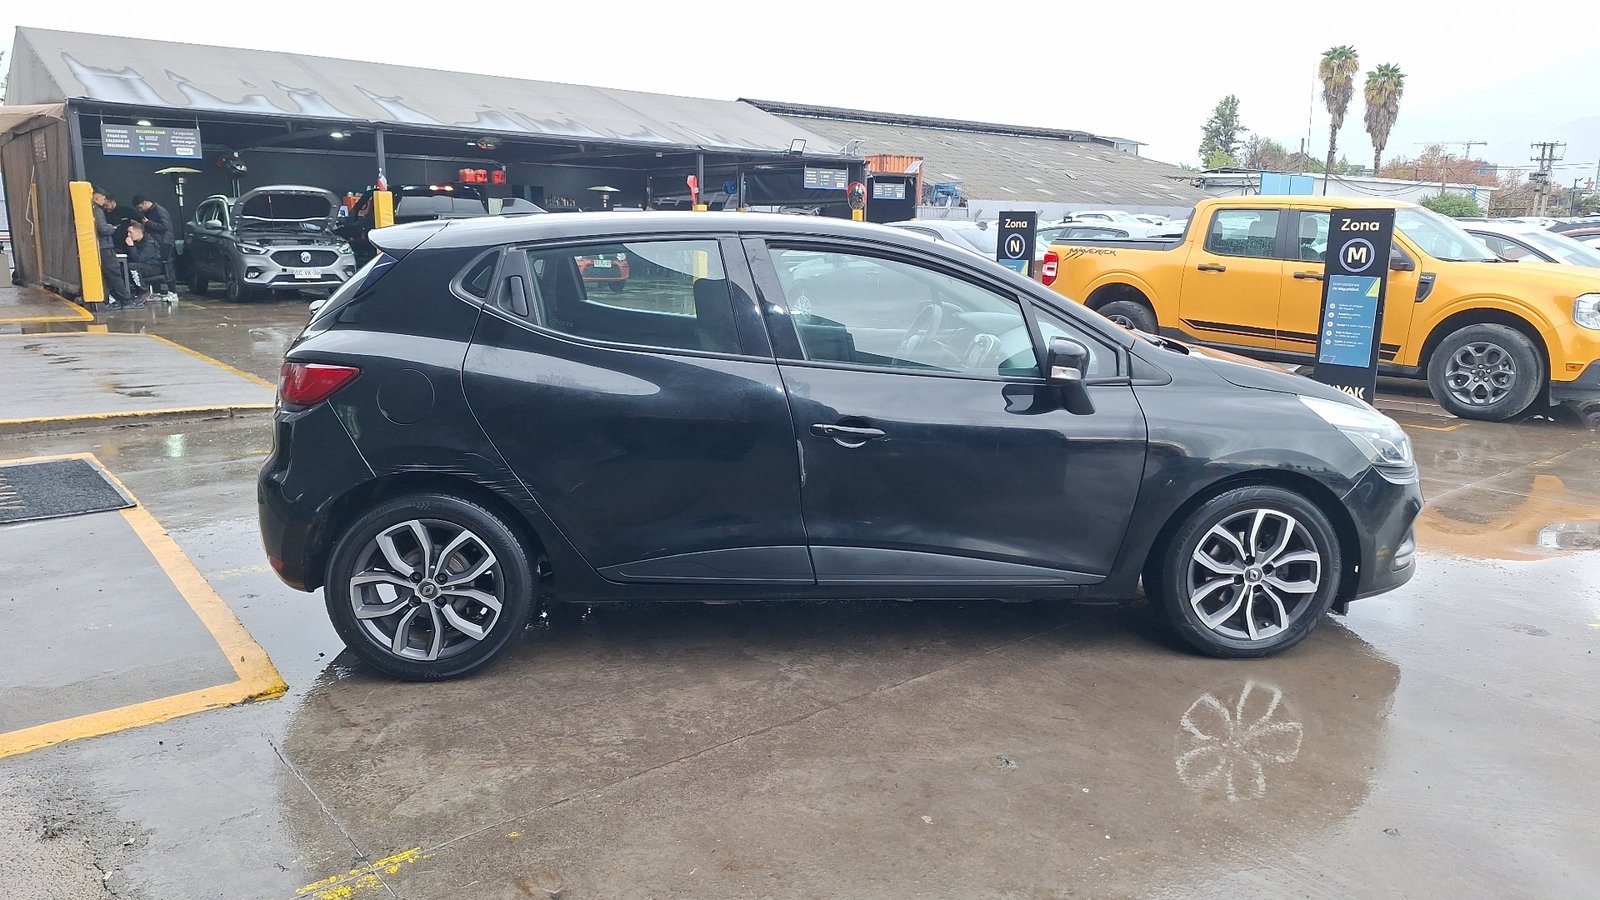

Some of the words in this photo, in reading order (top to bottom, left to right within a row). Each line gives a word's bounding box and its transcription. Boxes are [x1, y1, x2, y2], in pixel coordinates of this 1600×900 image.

[1005, 218, 1028, 228] Zona
[1341, 218, 1380, 231] Zona
[1010, 239, 1020, 253] N
[1066, 248, 1117, 258] MAVERICK
[1347, 246, 1367, 264] M
